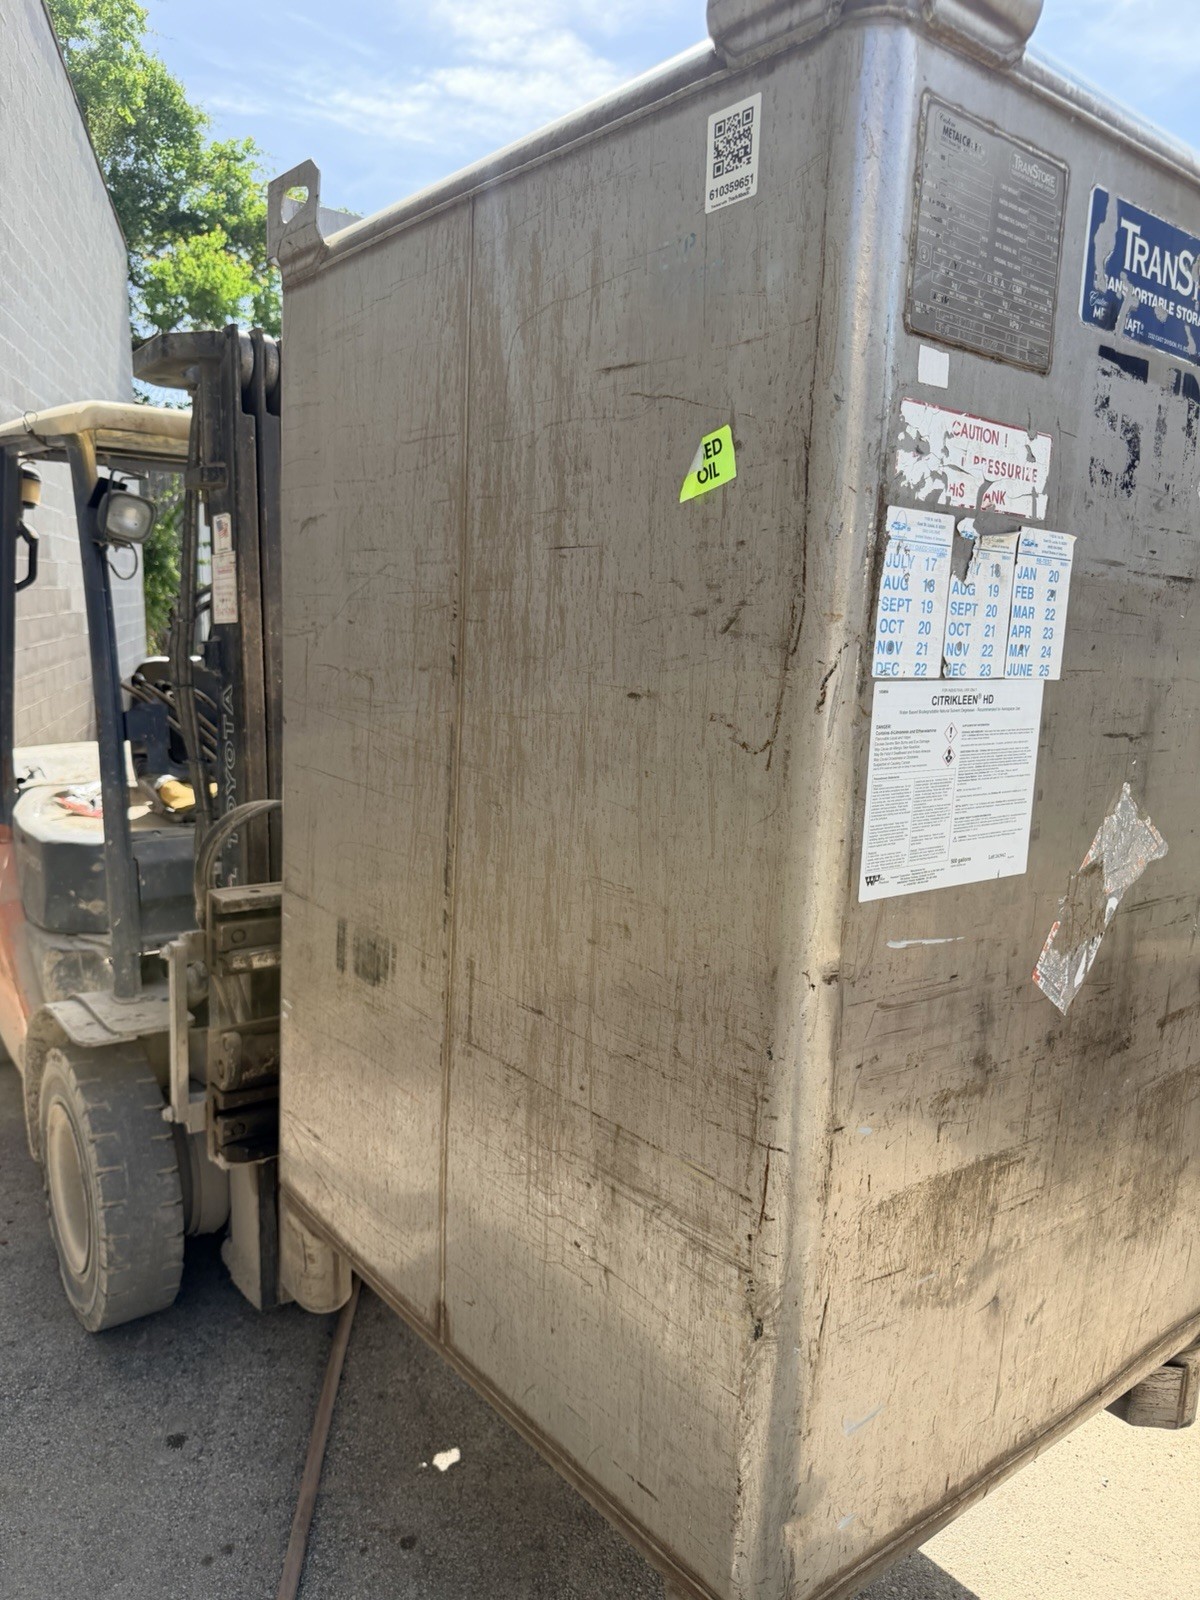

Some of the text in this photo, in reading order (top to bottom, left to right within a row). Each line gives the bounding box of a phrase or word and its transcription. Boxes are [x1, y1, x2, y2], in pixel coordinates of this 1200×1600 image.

[709, 173, 754, 201] 610359651
[952, 420, 999, 446] CAUTION
[703, 437, 722, 460] ED
[697, 462, 720, 484] OIL
[949, 482, 965, 498] HIS
[983, 490, 1007, 505] ANK
[885, 553, 937, 571] JULY 17
[1018, 566, 1059, 583] JAN 20
[883, 575, 935, 593] AUG 18
[952, 581, 999, 597] AUG 19
[1015, 585, 1034, 600] FEB
[881, 596, 933, 614] SEPT 19
[950, 601, 997, 618] SEPT 20
[1013, 605, 1055, 621] MAR 22
[880, 618, 931, 635] OCT 20
[948, 622, 995, 637] OCT 21
[1011, 625, 1053, 640] APR 23
[877, 640, 928, 656] NOV 21
[946, 642, 993, 657] NOV 22
[1009, 644, 1051, 658] MAY 24
[875, 662, 927, 676] DEC 22
[980, 664, 991, 677] 23
[1007, 663, 1050, 677] JUNE 25
[982, 694, 994, 704] HD
